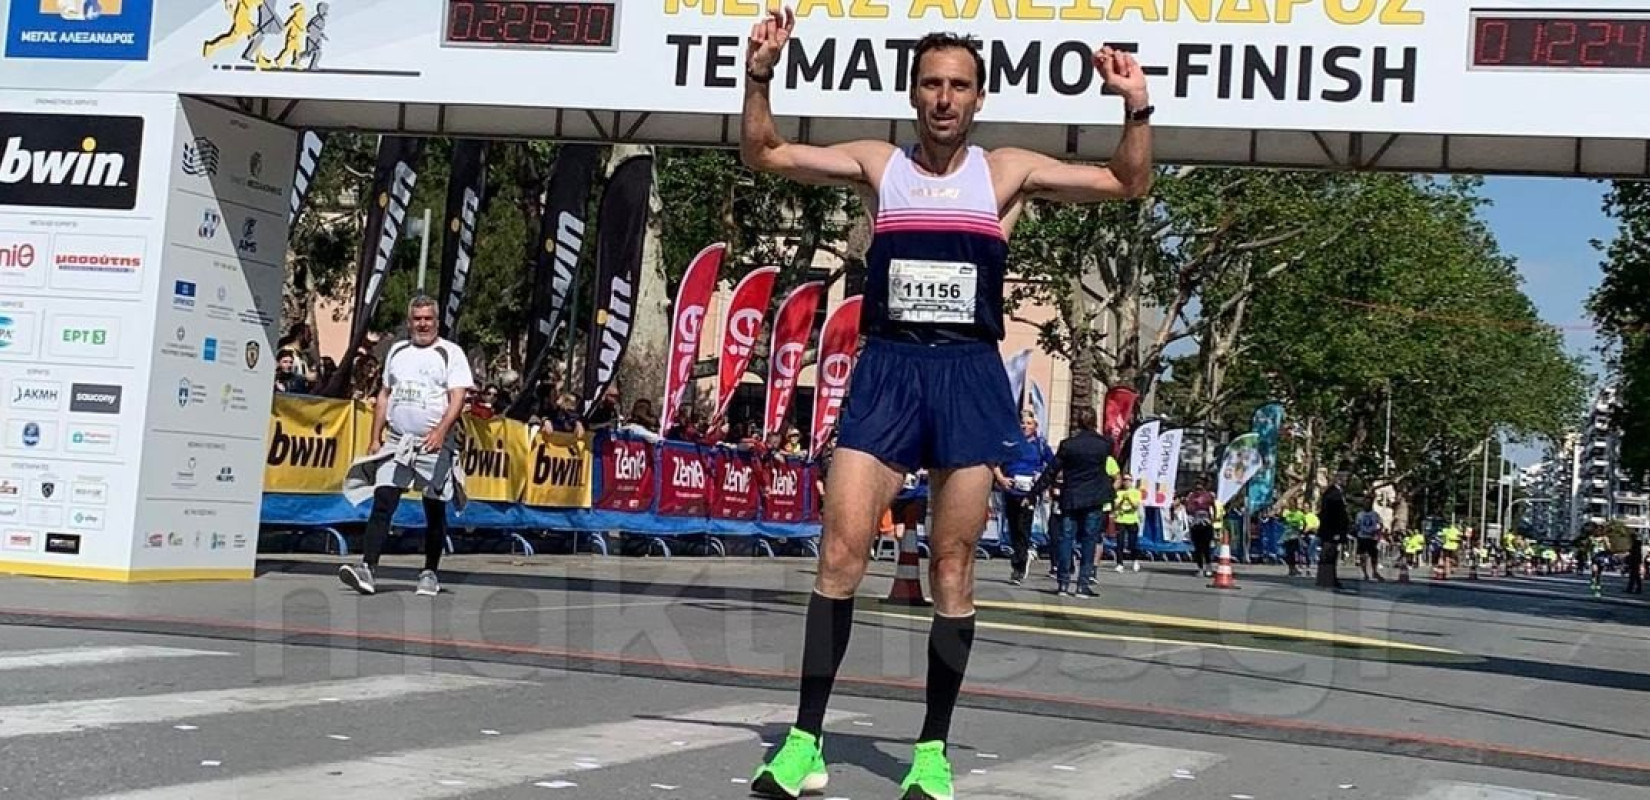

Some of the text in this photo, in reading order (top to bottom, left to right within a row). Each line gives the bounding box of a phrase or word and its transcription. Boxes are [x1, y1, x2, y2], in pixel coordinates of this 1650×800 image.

[21, 31, 135, 44] ΜΕΓΑΣ ΑΛΕΞΑΝΔΡΟΣ
[903, 282, 961, 299] 11156
[267, 421, 337, 469] bwin
